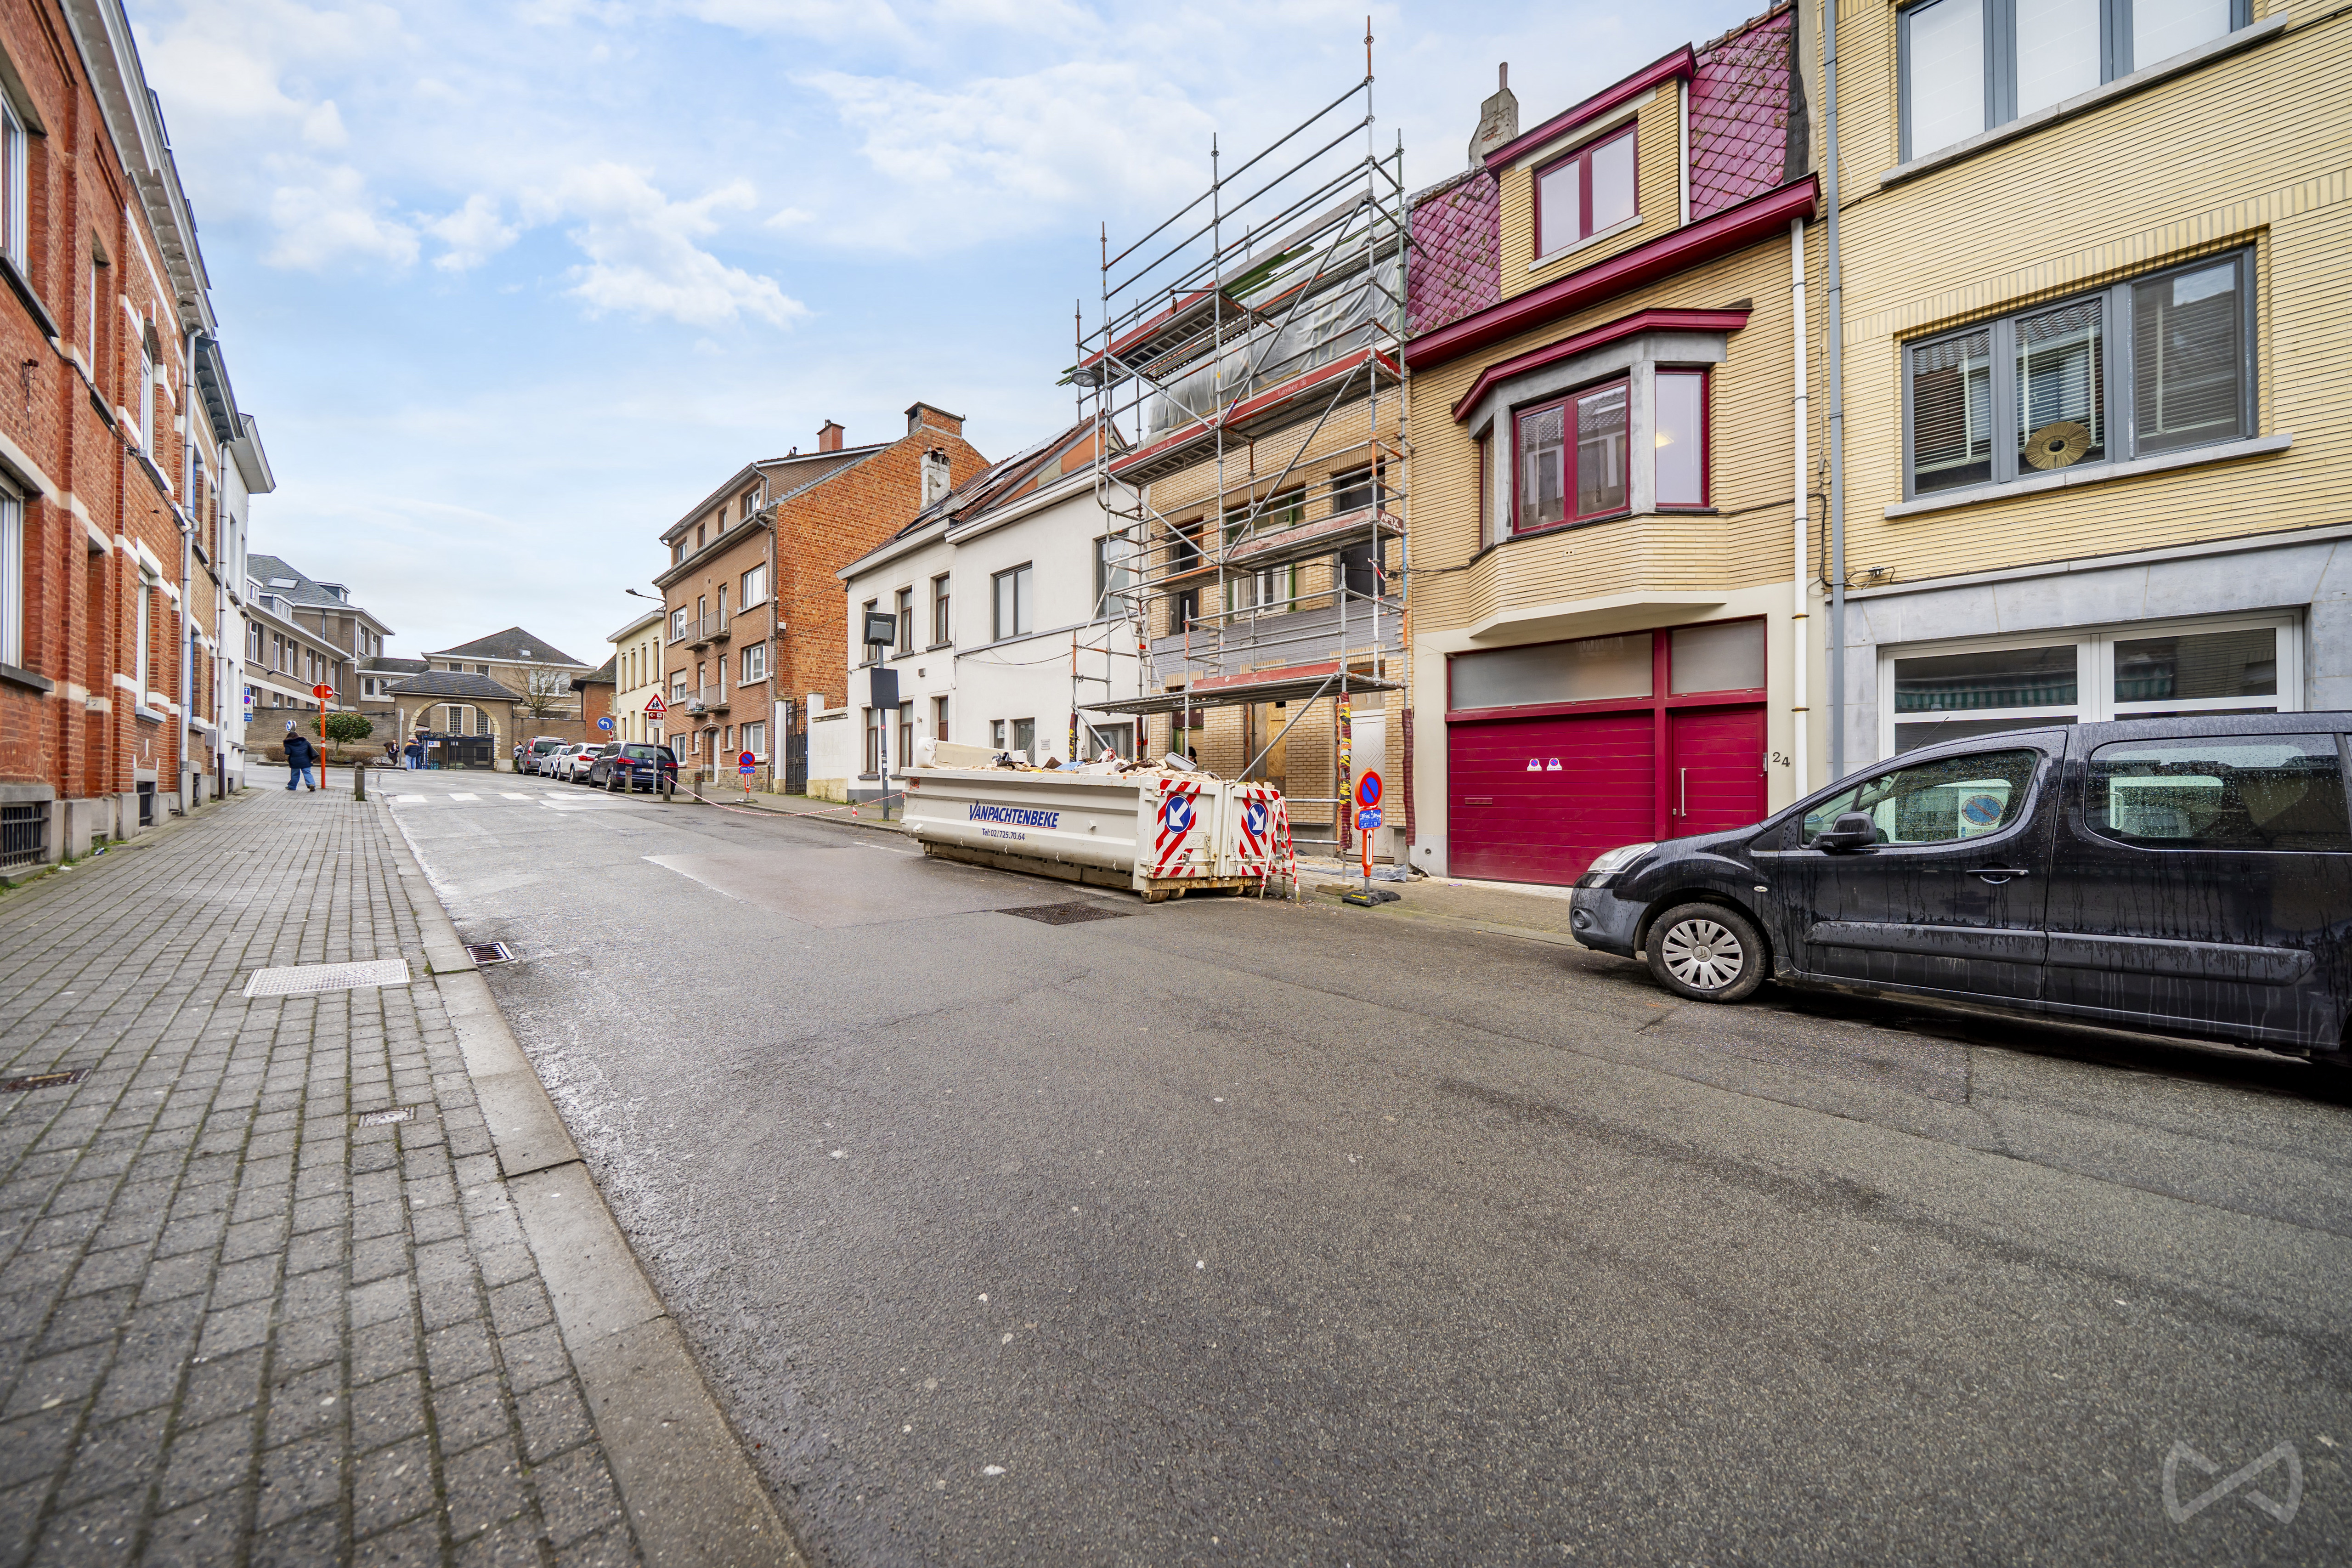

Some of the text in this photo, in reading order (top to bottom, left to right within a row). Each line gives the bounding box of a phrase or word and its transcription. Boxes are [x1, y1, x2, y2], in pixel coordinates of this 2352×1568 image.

[1148, 315, 1163, 328] Layher
[1278, 383, 1298, 396] Layher
[1151, 443, 1165, 453] Layher
[1380, 512, 1399, 527] AFIX
[1772, 752, 1790, 767] 24
[969, 800, 1060, 828] VANPACHTENBEKE
[990, 830, 1025, 841] 02/725.70.64
